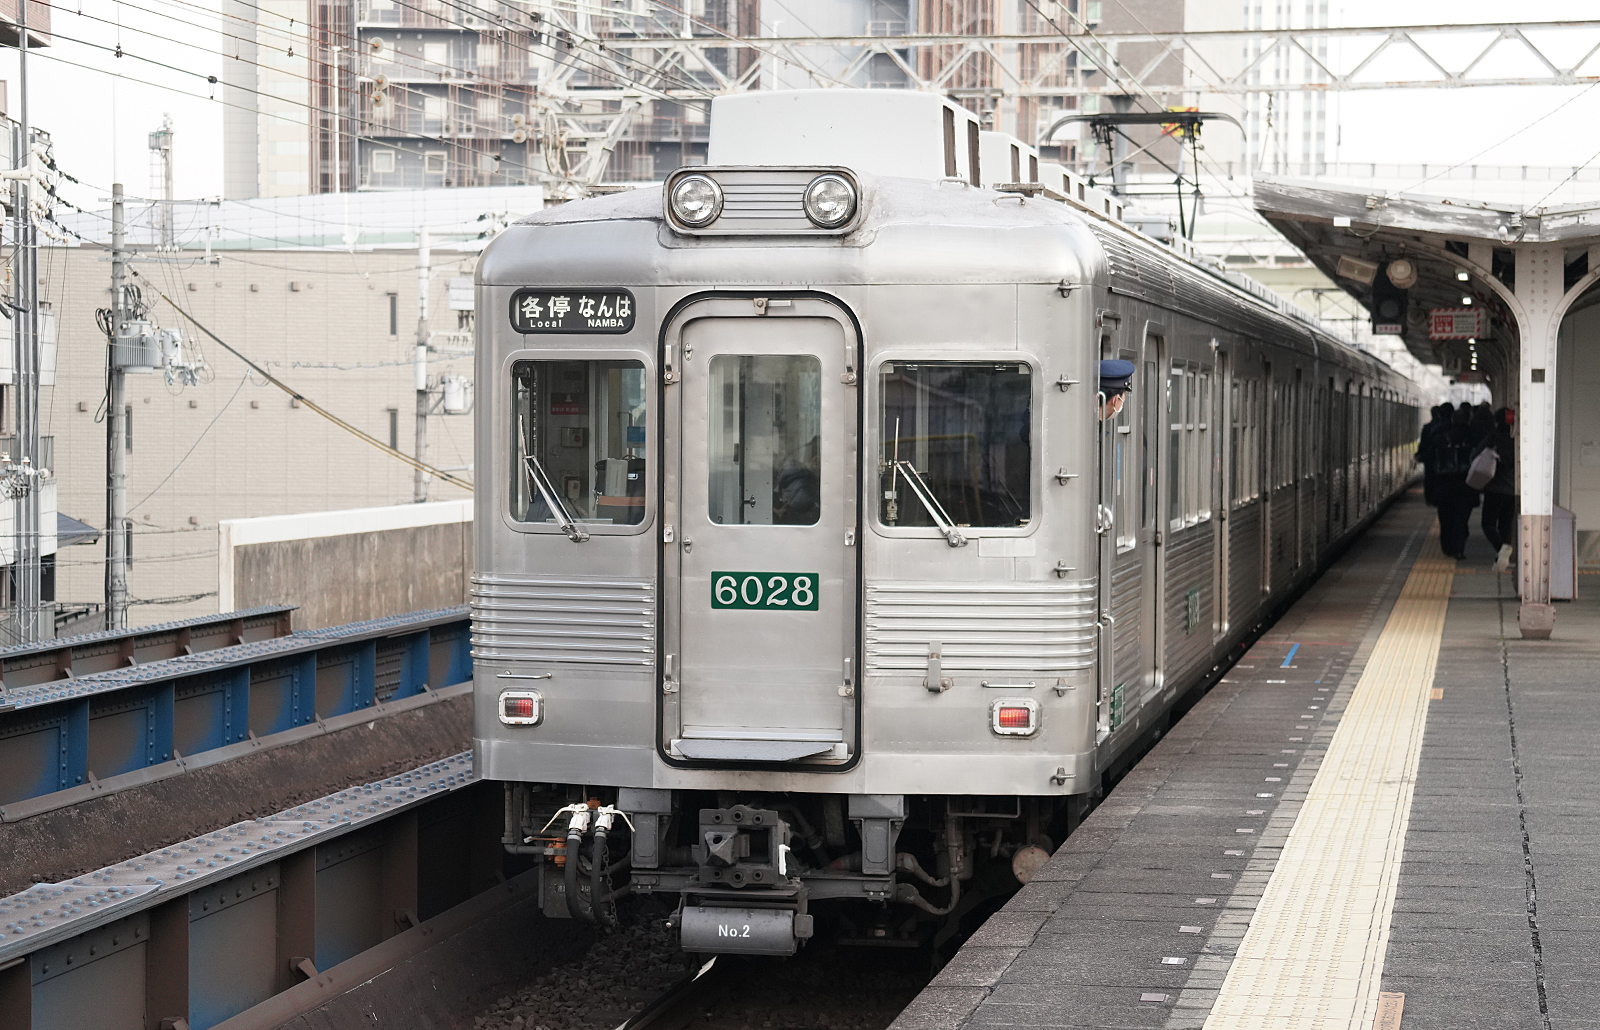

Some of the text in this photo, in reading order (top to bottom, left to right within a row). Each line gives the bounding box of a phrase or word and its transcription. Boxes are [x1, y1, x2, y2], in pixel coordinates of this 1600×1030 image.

[521, 296, 571, 318] 各停
[530, 319, 624, 328] Local NAMBA
[715, 575, 814, 606] 6028
[718, 924, 750, 938] No.2
